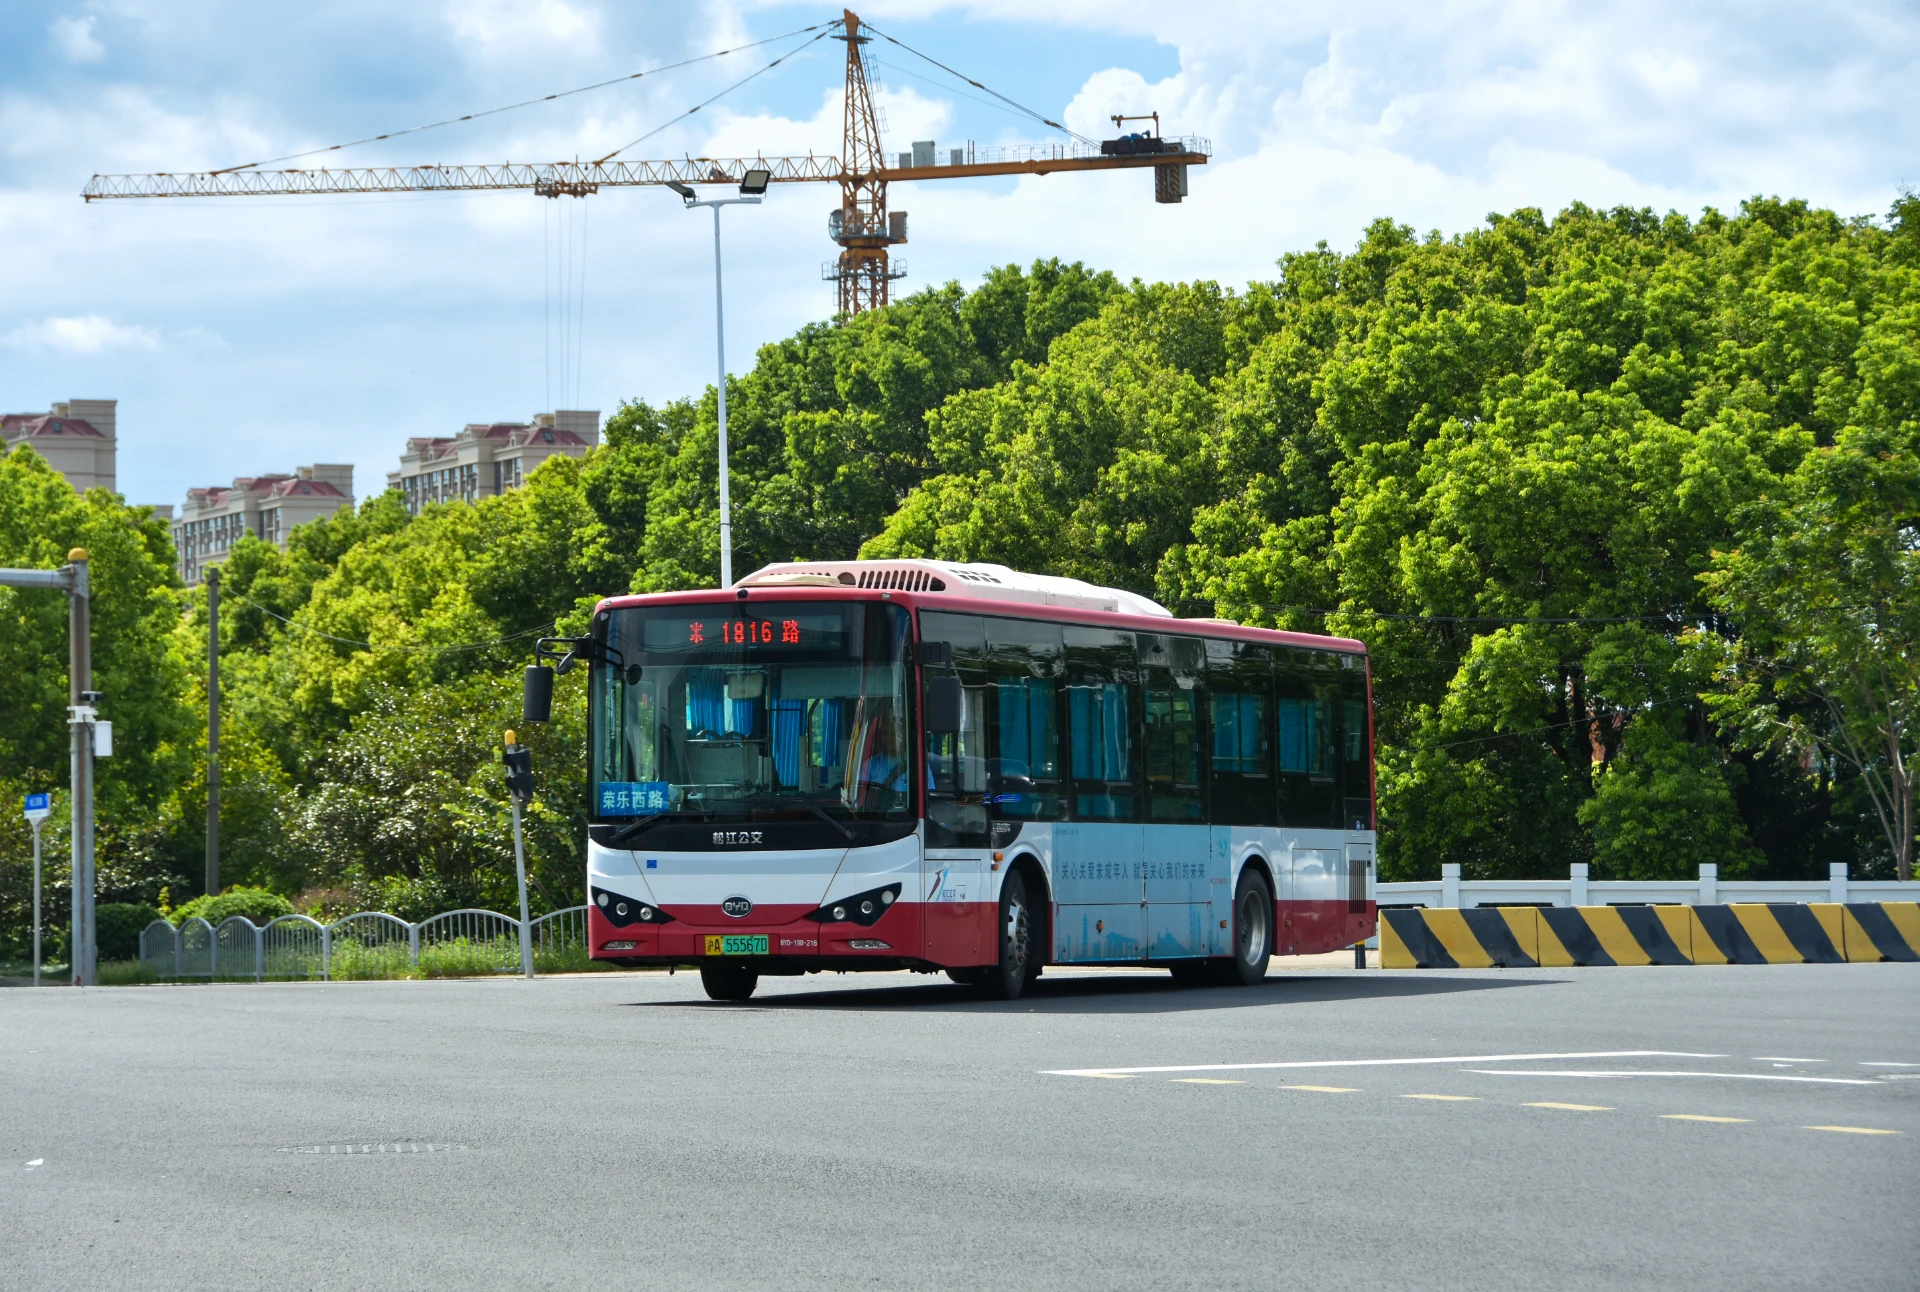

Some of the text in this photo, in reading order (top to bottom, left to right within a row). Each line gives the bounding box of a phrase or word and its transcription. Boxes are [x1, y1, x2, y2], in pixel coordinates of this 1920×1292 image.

[722, 619, 800, 643] 1816 路
[603, 790, 664, 809] 荣乐西路
[712, 831, 763, 845] 松江公交
[1061, 861, 1205, 880] 关心关爱未成年人 就是关心我们的未来
[724, 901, 749, 911] BYD
[726, 937, 768, 953] 55567D
